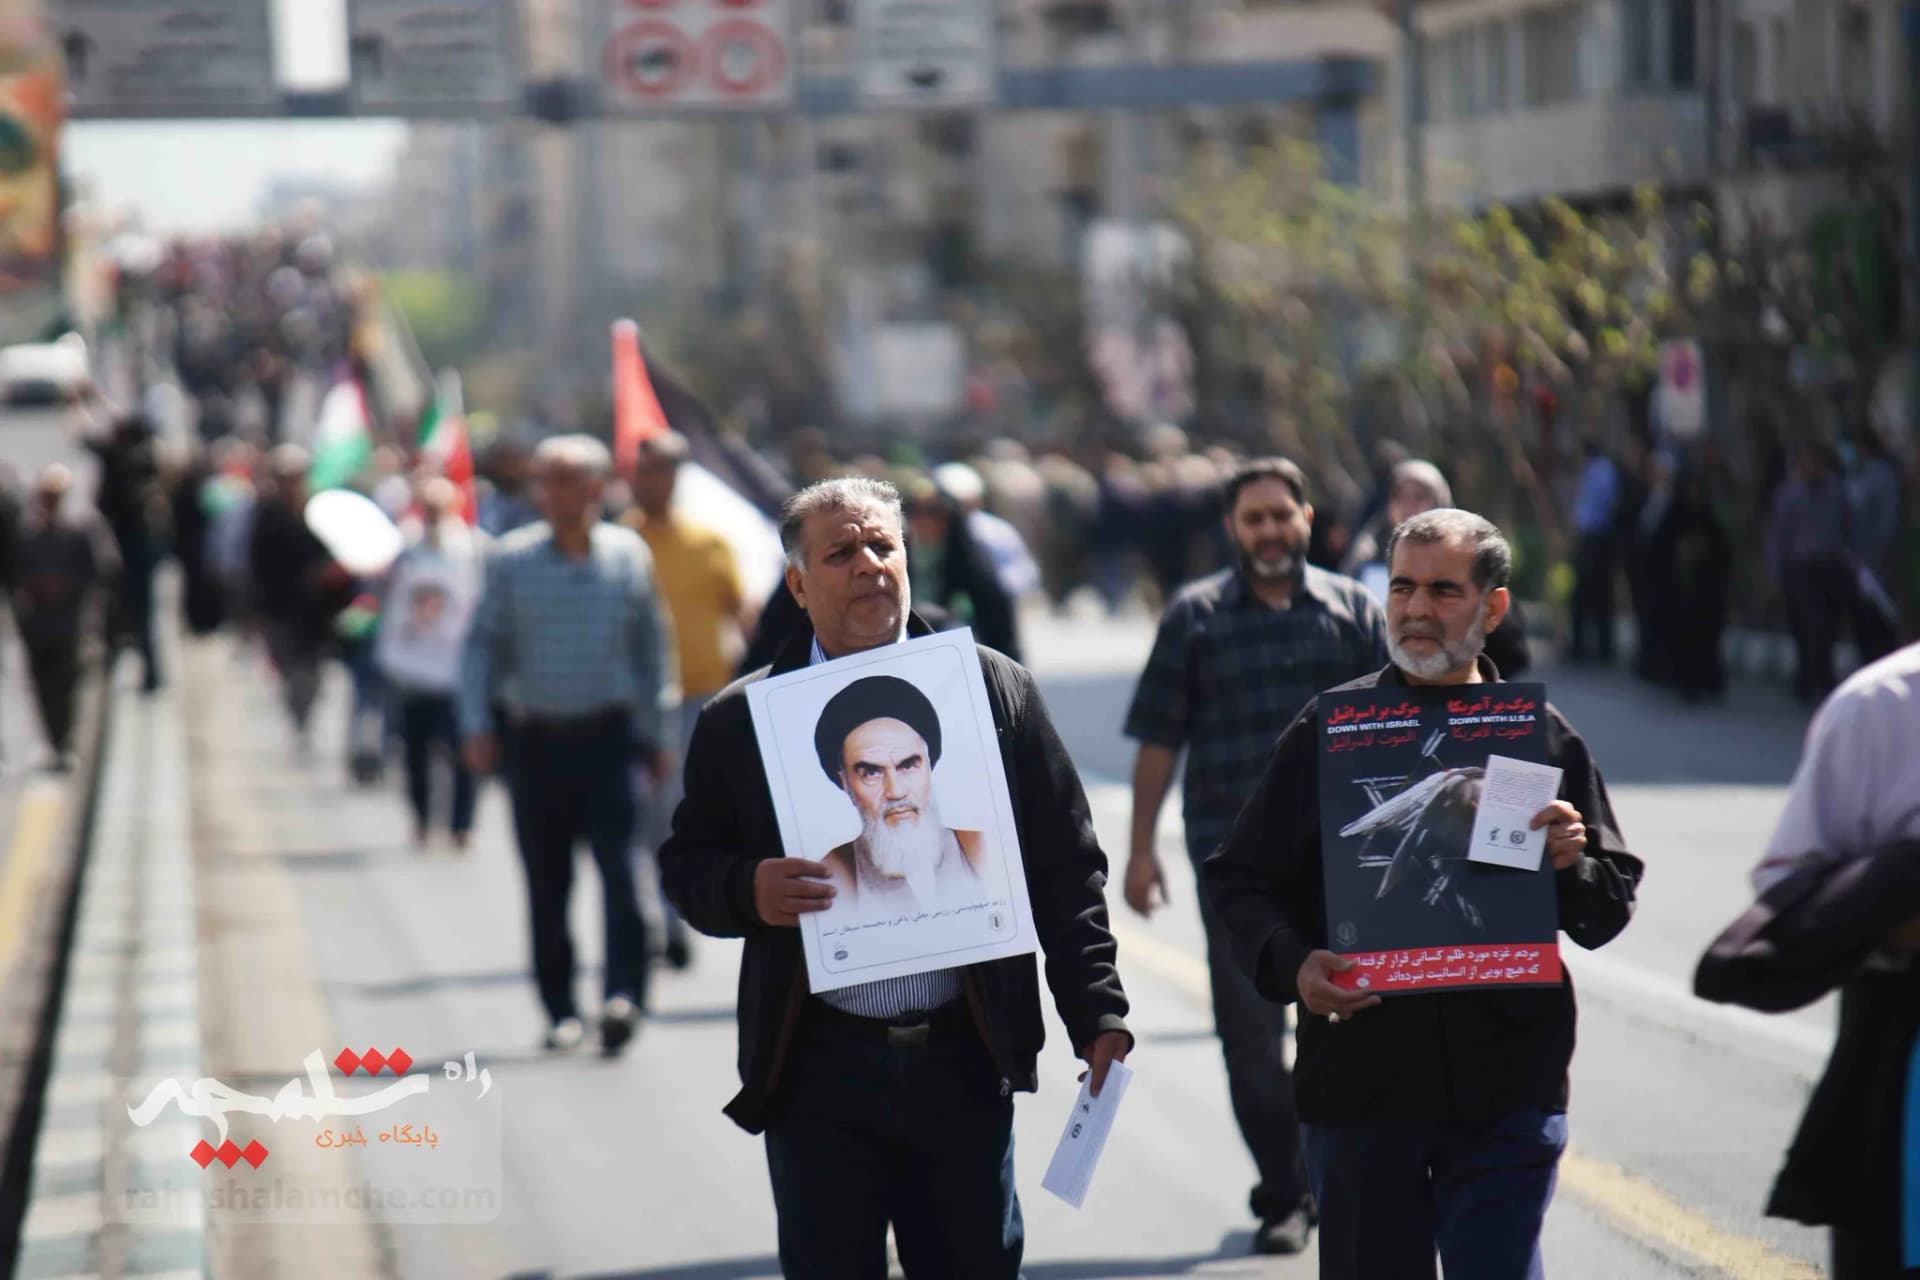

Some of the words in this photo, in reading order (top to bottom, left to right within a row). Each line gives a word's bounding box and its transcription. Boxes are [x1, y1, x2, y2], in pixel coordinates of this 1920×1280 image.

[1327, 725, 1358, 734] DOWN
[1359, 722, 1384, 731] WITH
[1385, 719, 1422, 729] ISRAEL
[1447, 717, 1480, 725] DOWN
[1481, 715, 1507, 723] WITH
[1491, 947, 1512, 962] غزه
[1514, 949, 1540, 961] مردم
